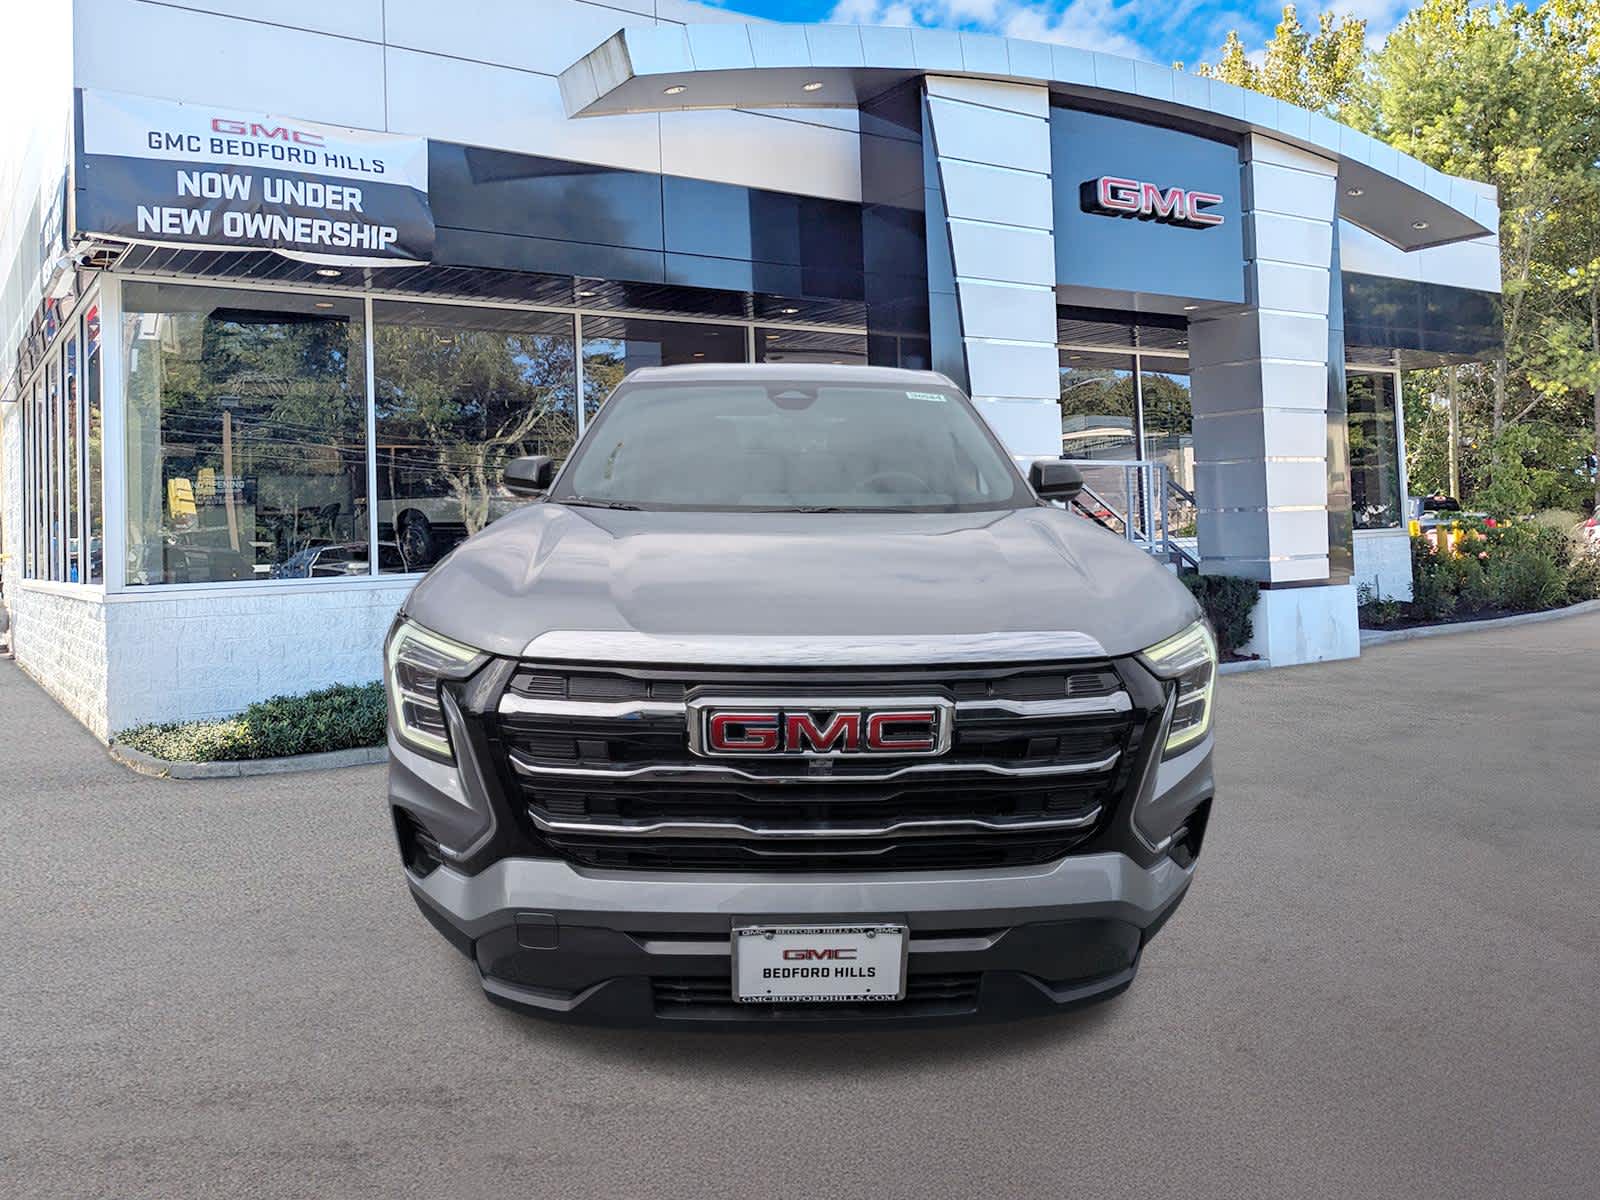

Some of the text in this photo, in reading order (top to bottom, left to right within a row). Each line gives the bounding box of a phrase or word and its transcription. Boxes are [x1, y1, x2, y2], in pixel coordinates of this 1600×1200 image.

[148, 131, 385, 174] GMC BEDFORD HILLS
[211, 117, 325, 148] GMC
[177, 170, 363, 213] NOW UNDER
[1097, 175, 1225, 224] GMC
[137, 205, 398, 251] NEW OWNERSHIP
[709, 711, 937, 753] GMC
[775, 928, 821, 936] BEDFORD
[822, 928, 851, 936] HILLS
[763, 967, 876, 979] BEDFORD HILLS
[782, 948, 857, 961] GMC
